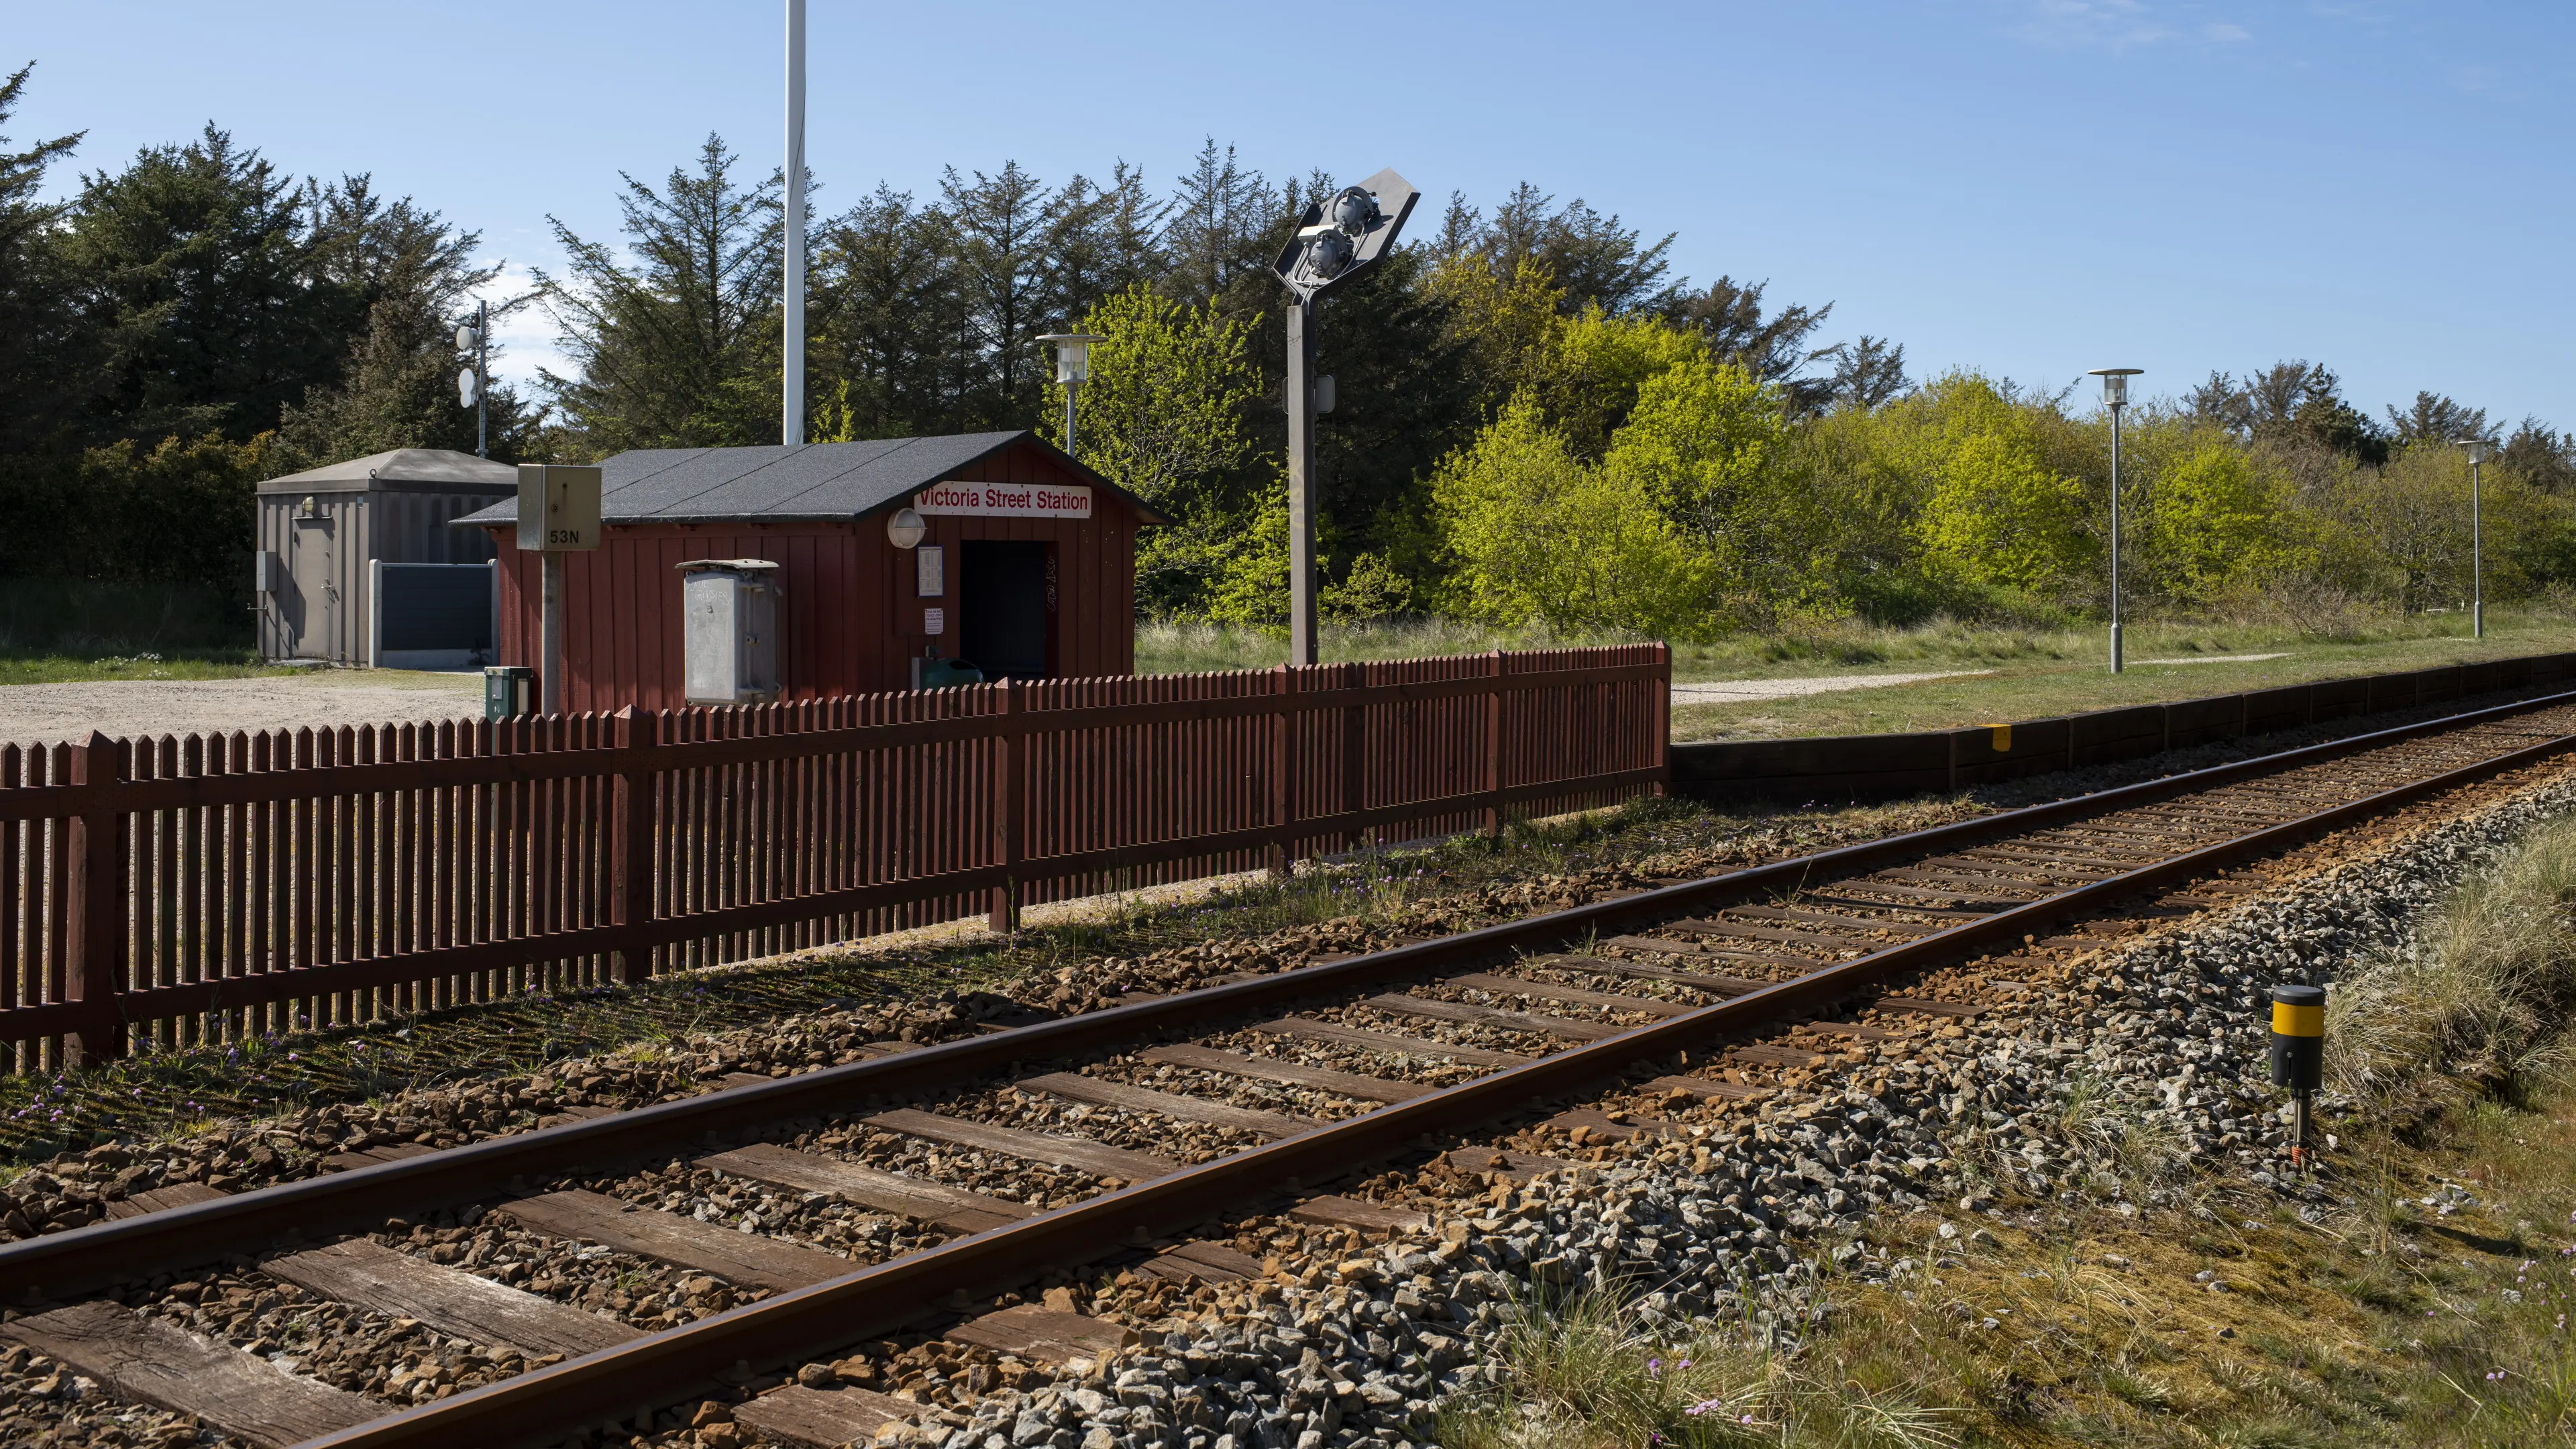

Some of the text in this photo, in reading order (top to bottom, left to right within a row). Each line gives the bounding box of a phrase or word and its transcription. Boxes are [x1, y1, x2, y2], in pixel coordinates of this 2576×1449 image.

[921, 488, 1087, 510] Victoria Street Station
[550, 530, 579, 543] 53N
